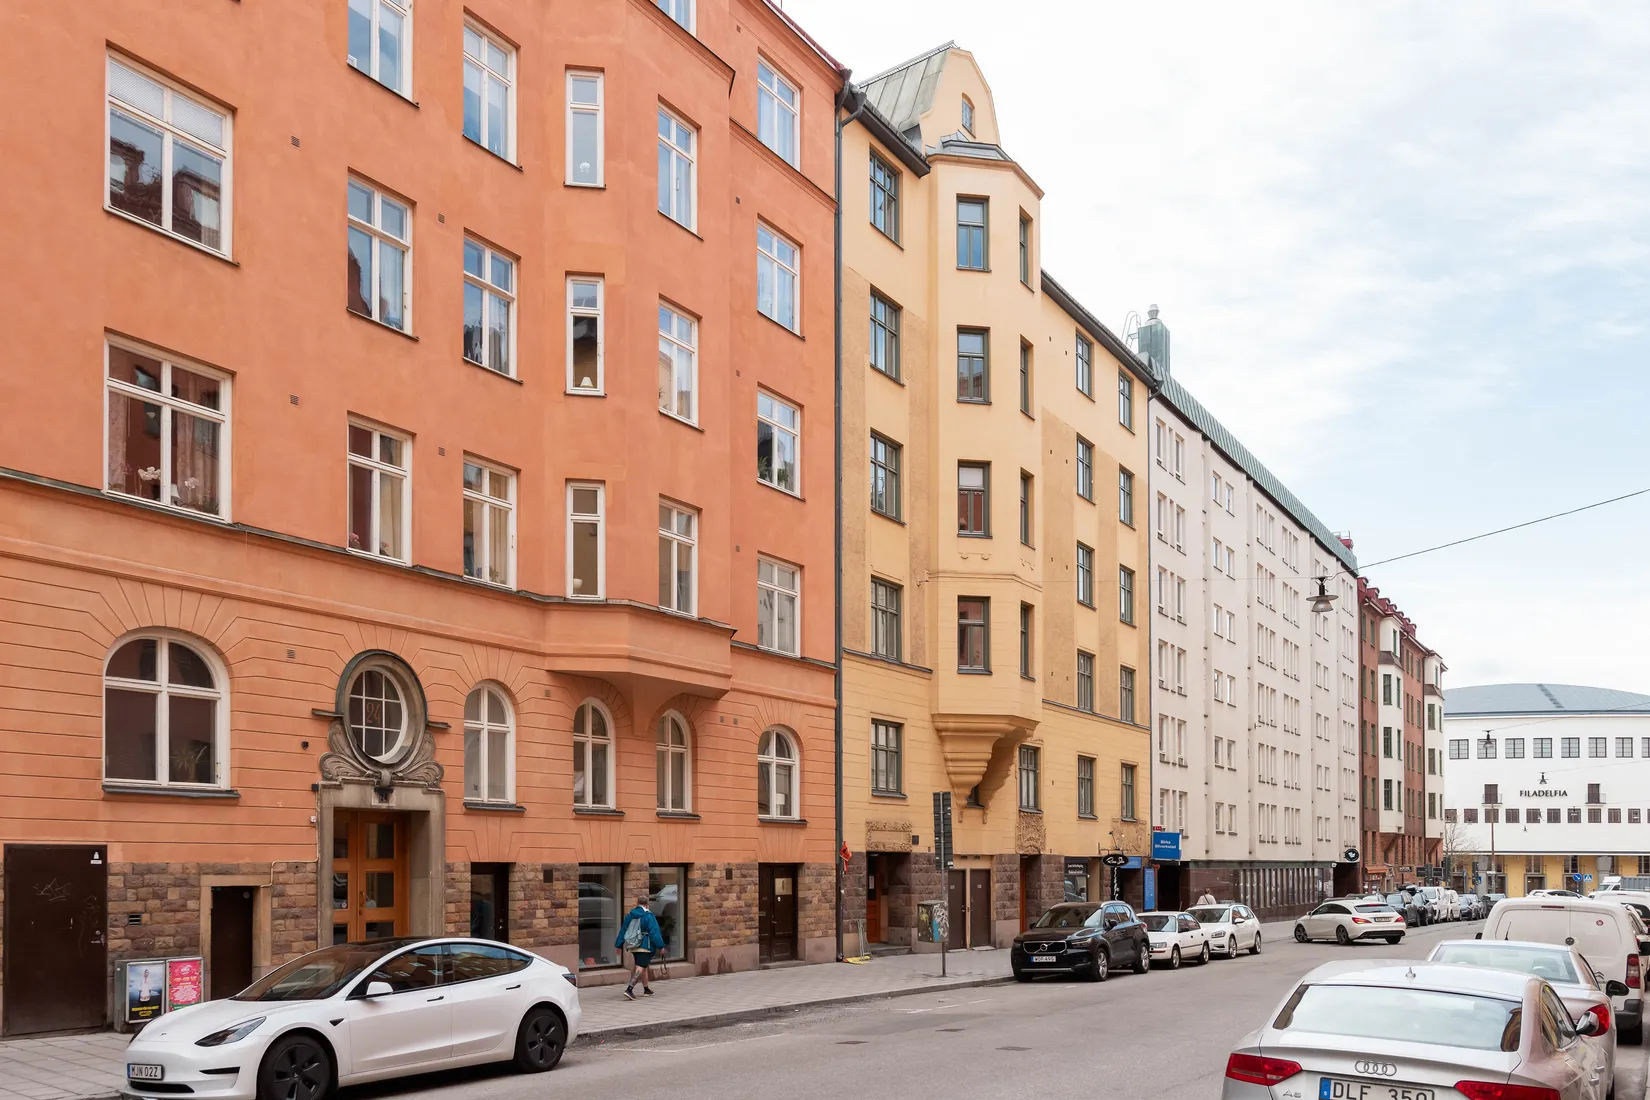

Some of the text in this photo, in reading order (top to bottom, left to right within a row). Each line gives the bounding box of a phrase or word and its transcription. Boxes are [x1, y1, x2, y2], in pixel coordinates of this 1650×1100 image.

[366, 702, 380, 724] 24
[1520, 789, 1568, 797] FILADELFIA
[131, 1065, 143, 1076] MJN
